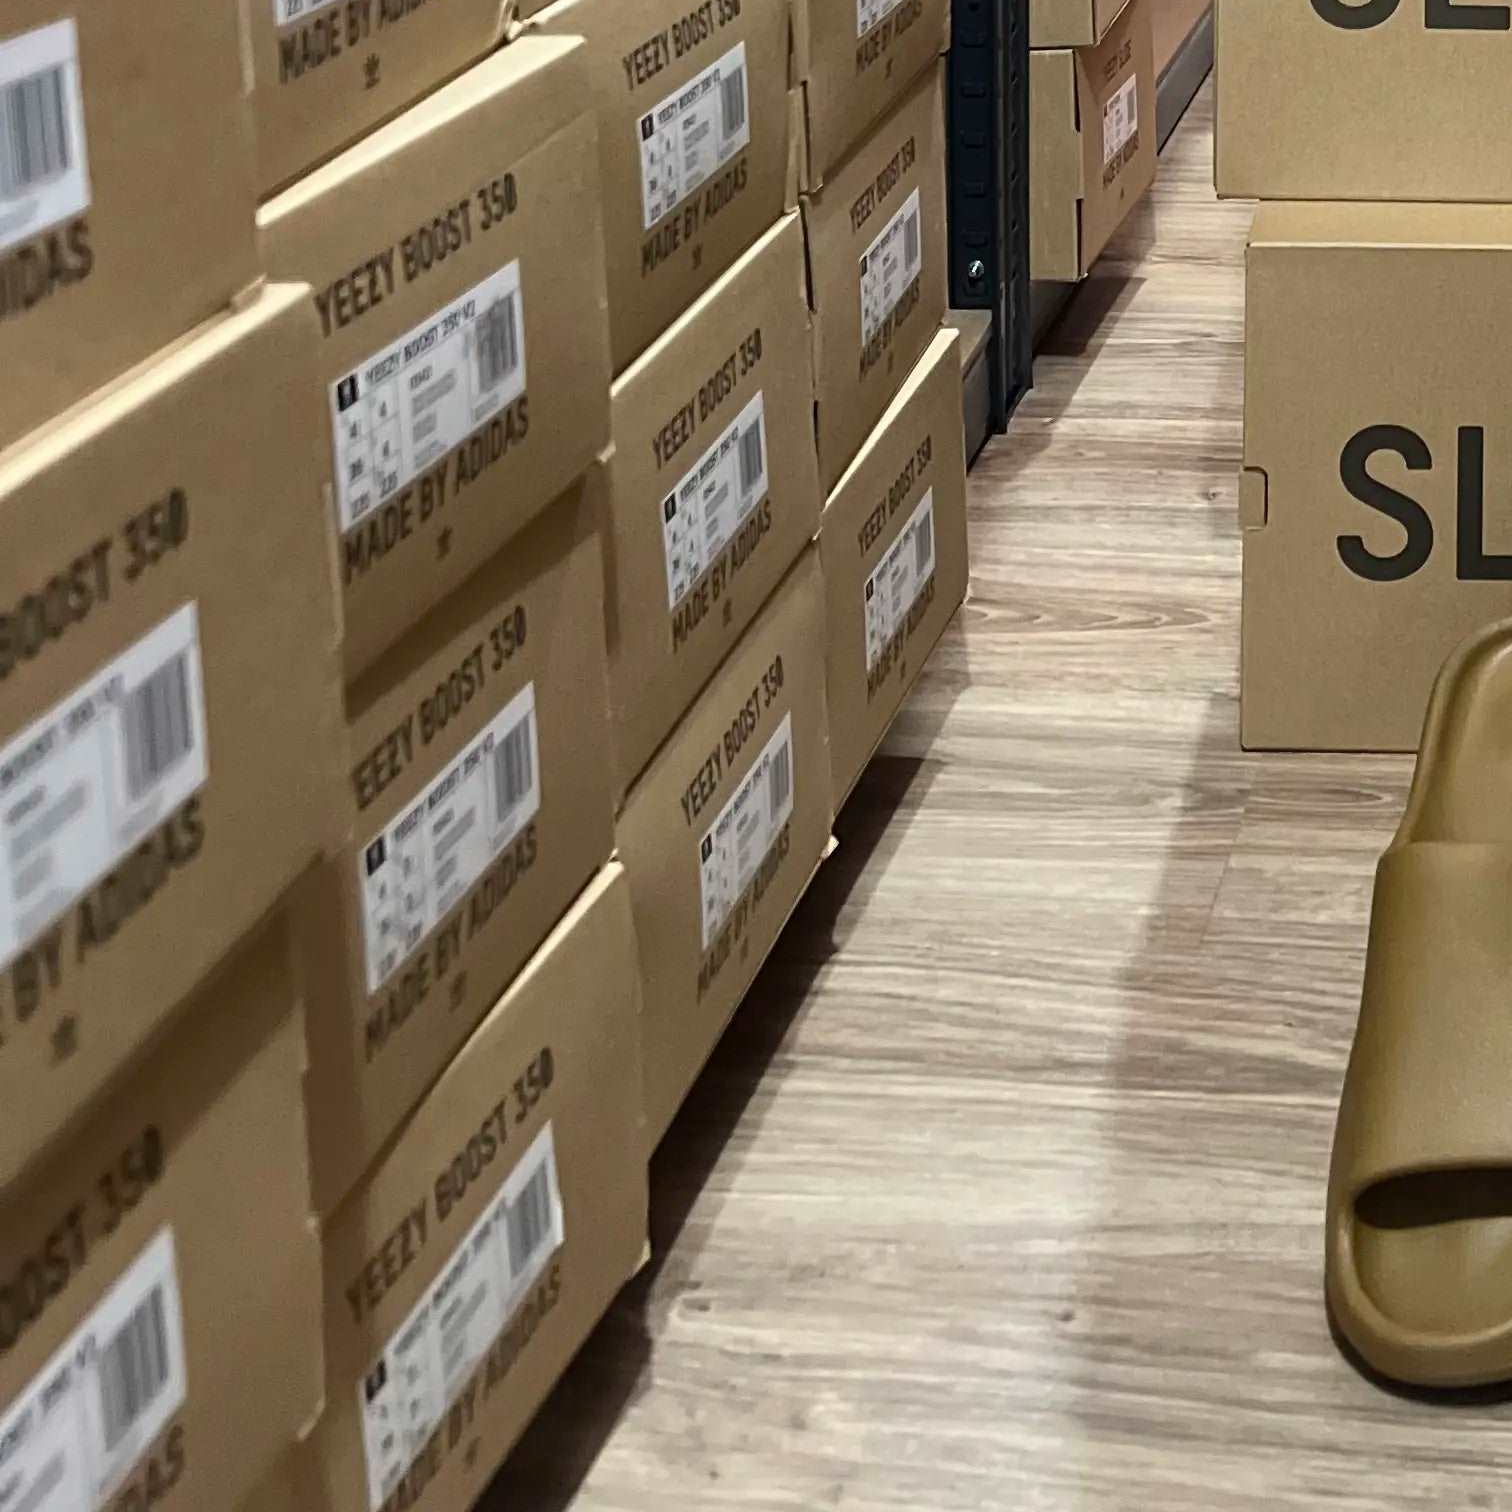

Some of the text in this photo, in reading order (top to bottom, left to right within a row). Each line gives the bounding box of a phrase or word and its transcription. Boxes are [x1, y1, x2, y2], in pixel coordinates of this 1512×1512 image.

[279, 5, 342, 87] MADE
[622, 29, 672, 91] YEEZY
[313, 172, 518, 338] YEEZY BOOST 350
[641, 214, 682, 281] MADE
[683, 194, 702, 243] BY
[651, 327, 763, 472] YEEZY BOOST 350
[342, 488, 413, 587] MADE
[420, 465, 449, 526] BY
[455, 395, 529, 495] ADIDAS
[671, 575, 710, 654] MADE
[710, 556, 729, 605] BY
[350, 603, 528, 812] EEZY BOOST 350
[679, 653, 784, 827] YEEZY BOOST 350
[347, 1046, 556, 1326] YEEZY BOOST 350
